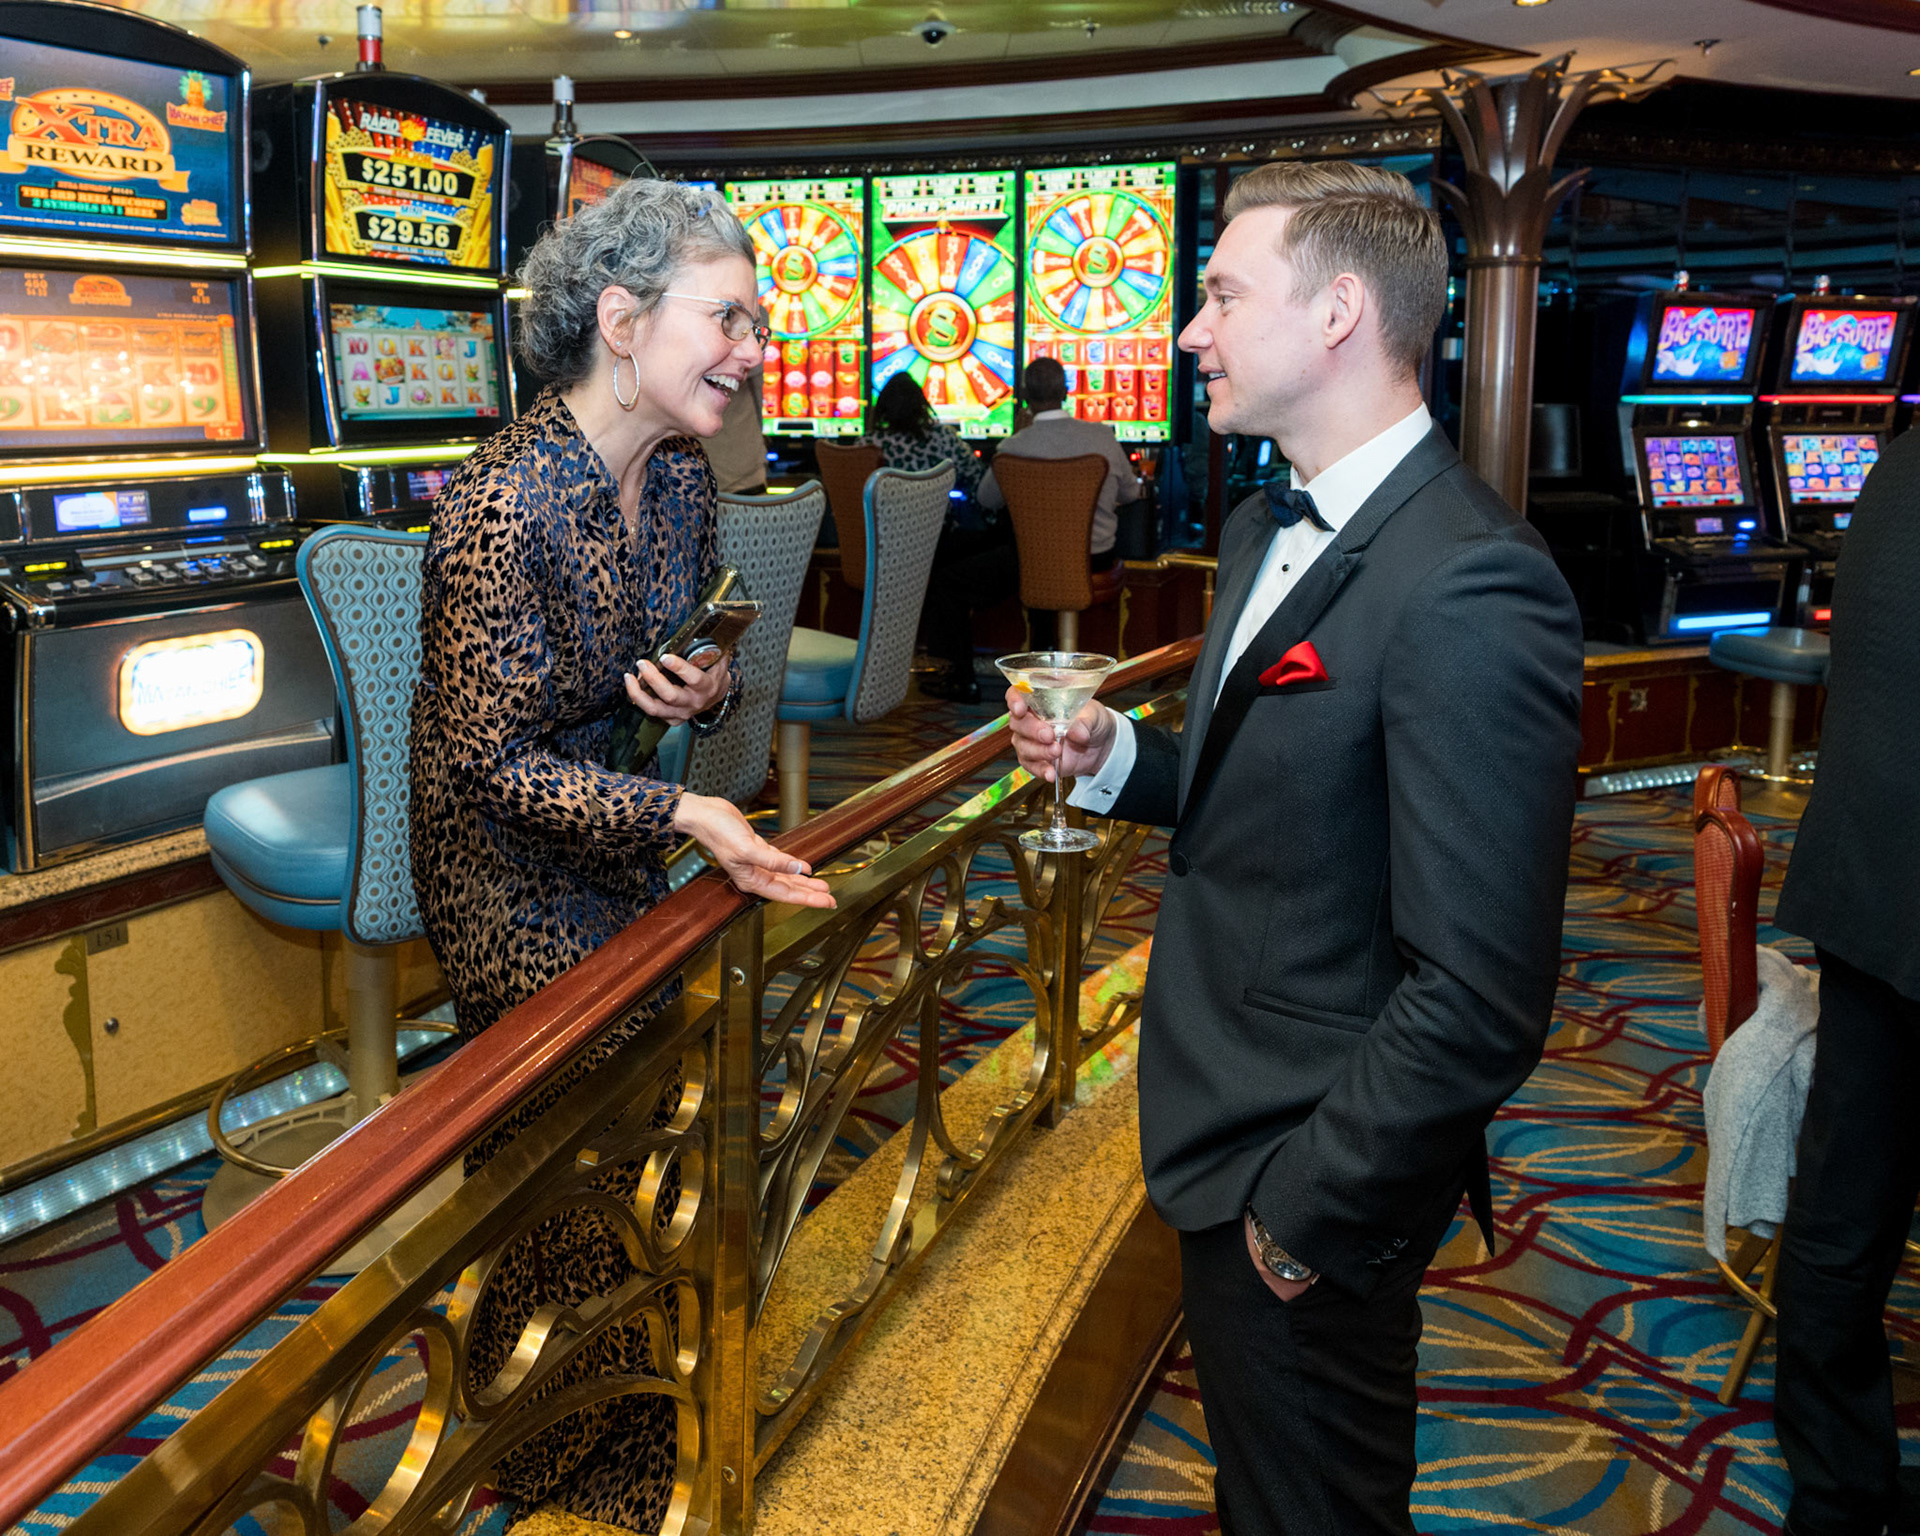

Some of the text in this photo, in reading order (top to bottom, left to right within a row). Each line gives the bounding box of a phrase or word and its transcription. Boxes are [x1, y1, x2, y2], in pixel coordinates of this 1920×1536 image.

[15, 96, 163, 148] XTRA
[201, 111, 226, 127] CHIEF
[360, 113, 464, 147] RAPID FEVER
[26, 144, 163, 173] REWARD
[362, 158, 458, 196] $251.00
[21, 186, 48, 198] THE
[43, 198, 99, 213] SYMBOLS
[368, 217, 450, 248] $29.56
[1658, 310, 1749, 351] BIG SURF
[1798, 313, 1892, 352] BIG SURF
[348, 337, 369, 355] 10
[378, 338, 397, 356] Q
[409, 339, 426, 357] K
[464, 340, 477, 358] J
[185, 362, 219, 387] 10
[351, 361, 372, 381] A
[411, 363, 427, 381] K
[385, 386, 400, 405] J
[440, 387, 456, 404] K
[467, 387, 483, 404] K
[193, 396, 217, 418] 9
